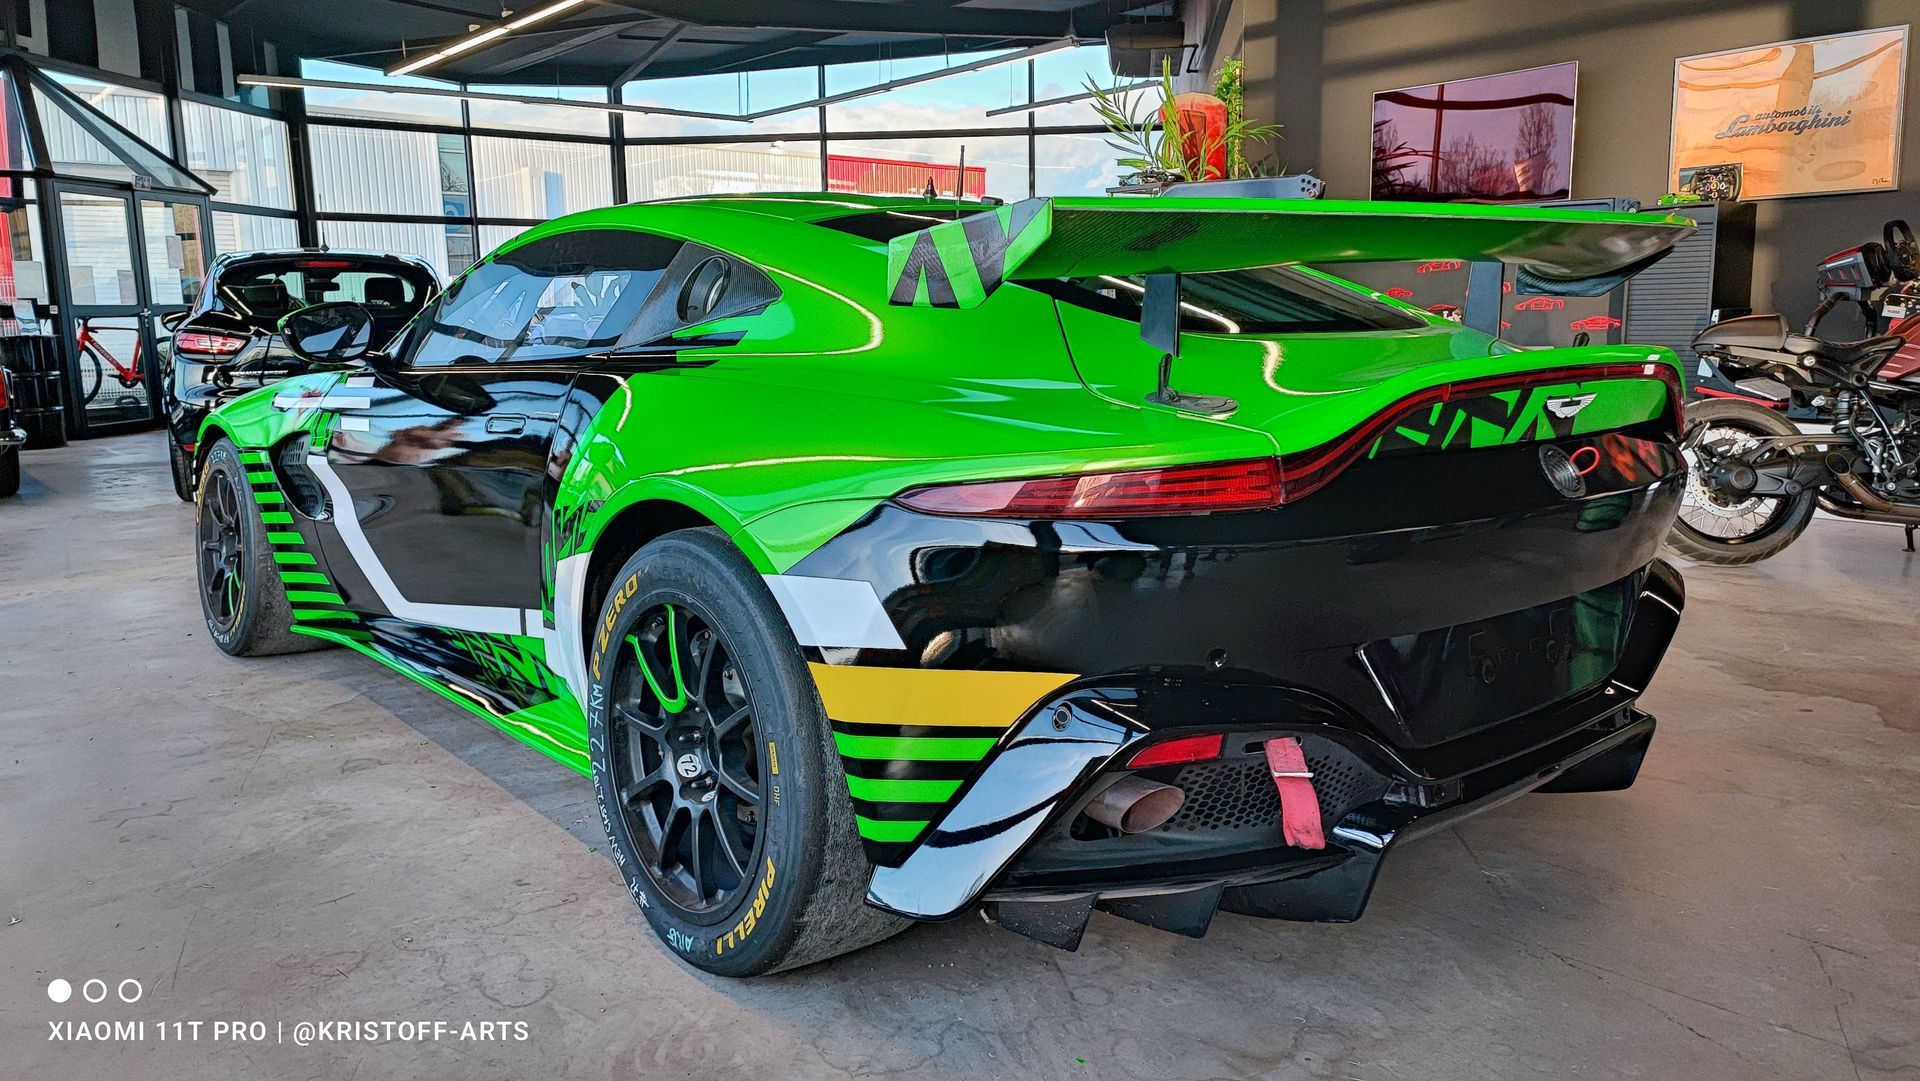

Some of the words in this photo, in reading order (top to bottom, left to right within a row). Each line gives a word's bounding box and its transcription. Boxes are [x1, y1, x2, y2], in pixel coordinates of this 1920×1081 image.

[1715, 110, 1852, 139] Lamborghini
[598, 572, 639, 655] ZERO
[680, 755, 699, 776] 72
[716, 855, 776, 955] PIRELLI
